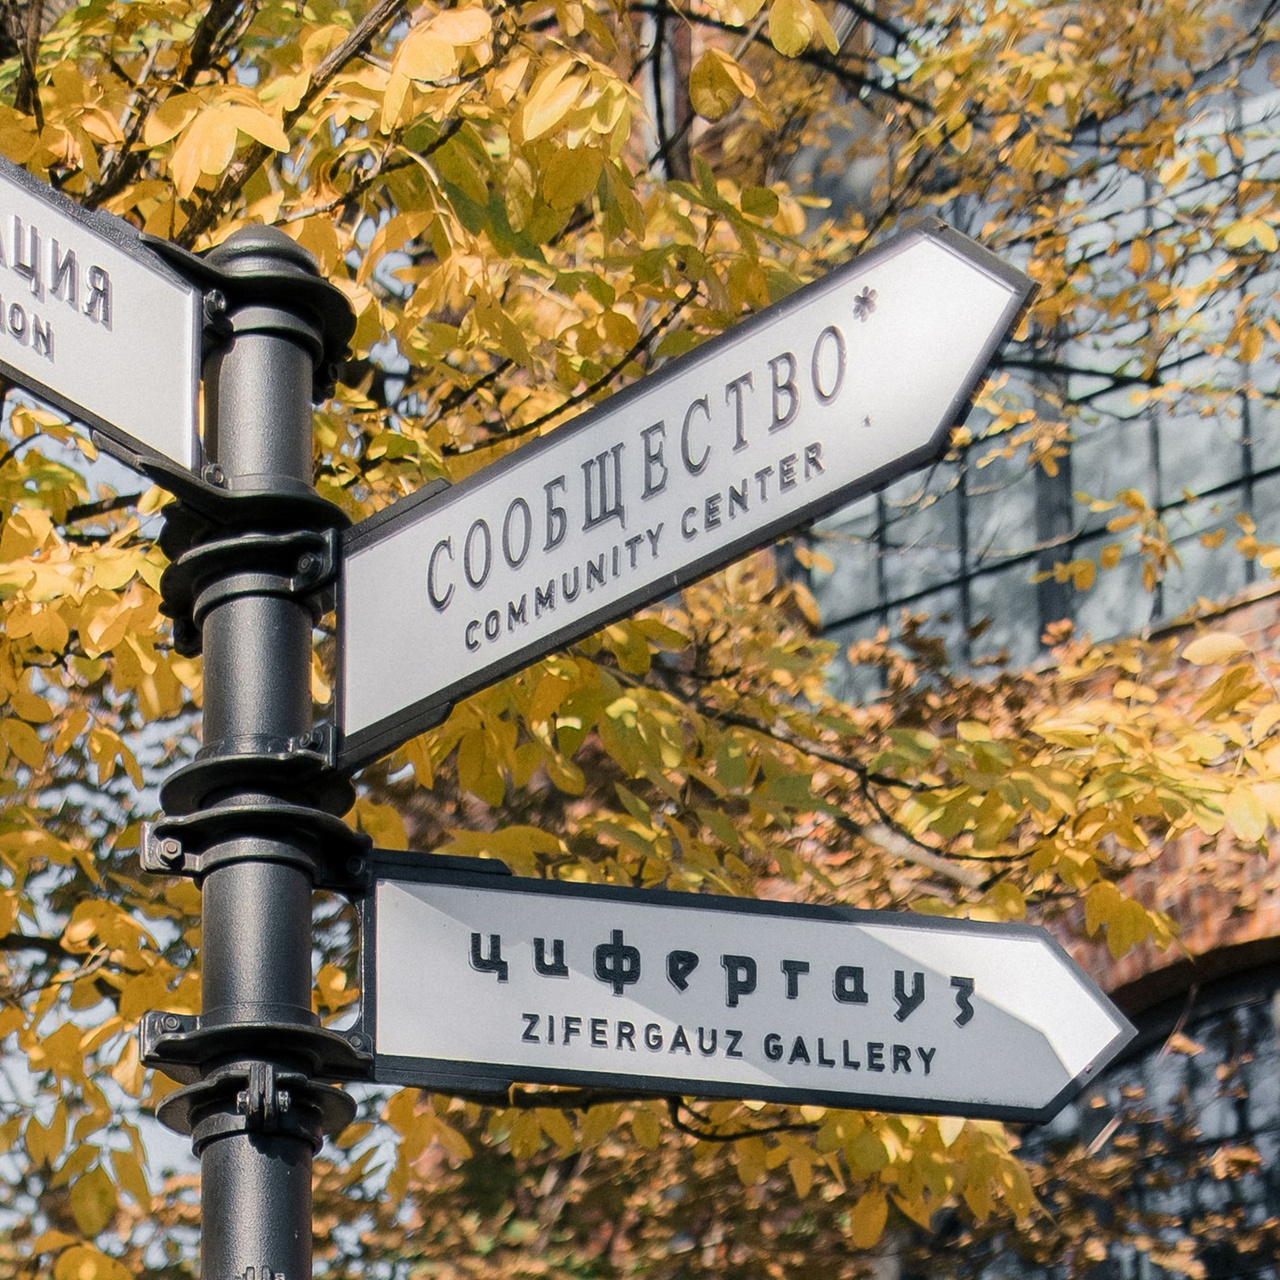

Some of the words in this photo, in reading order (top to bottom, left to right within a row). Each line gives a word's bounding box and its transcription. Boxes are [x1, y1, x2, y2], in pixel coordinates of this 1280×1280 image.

[464, 521, 664, 652] COMMUNITY
[681, 441, 826, 541] CENTER
[521, 1013, 744, 1059] ZIFERGAUZ
[763, 1032, 937, 1076] GALLERY
